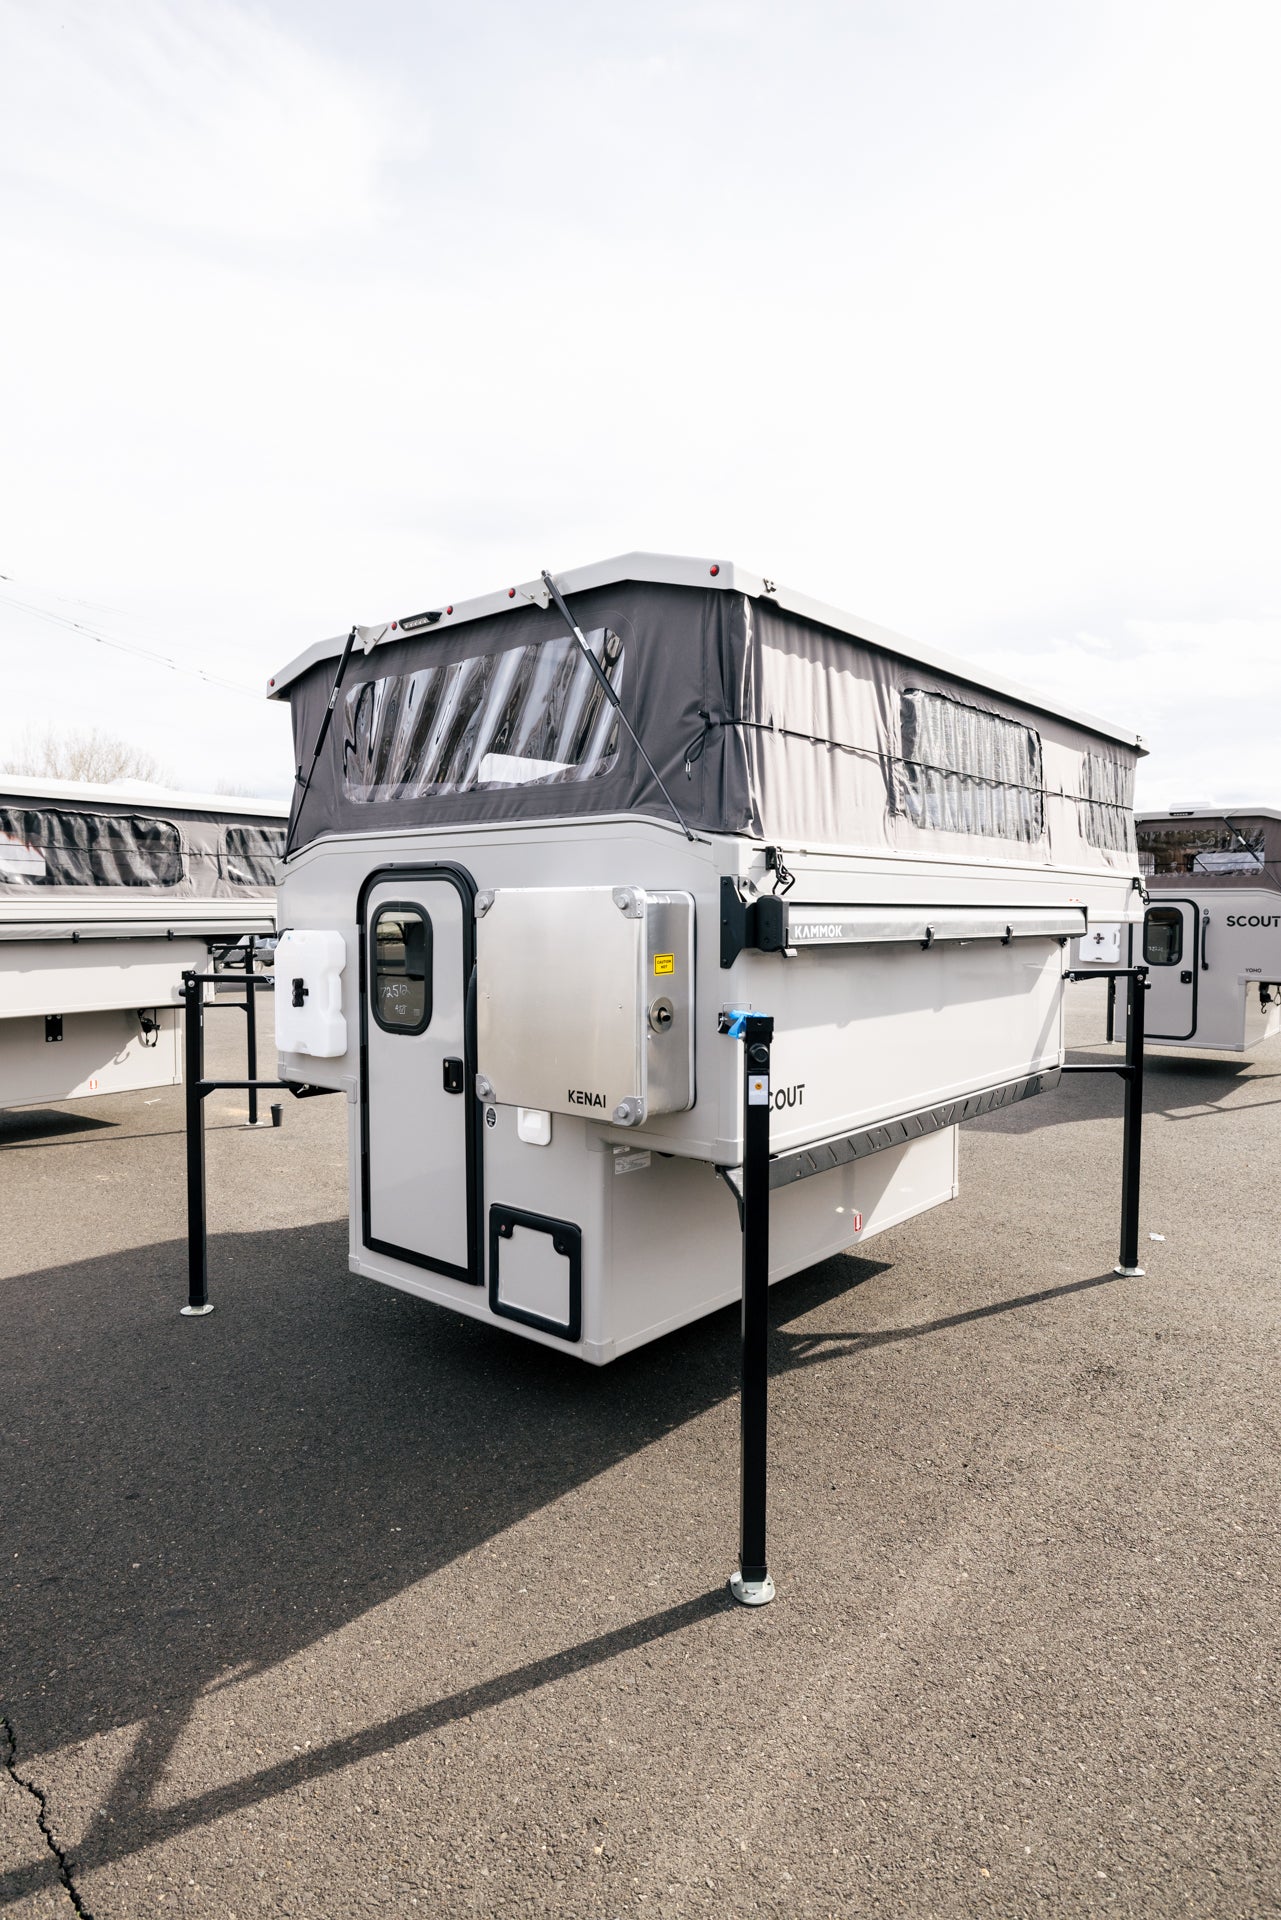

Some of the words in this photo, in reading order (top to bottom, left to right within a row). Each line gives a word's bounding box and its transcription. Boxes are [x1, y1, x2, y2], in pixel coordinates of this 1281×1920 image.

[1226, 915, 1281, 927] SCOUT
[794, 924, 843, 938] KAMMOK
[568, 1089, 606, 1108] KENAI
[769, 1083, 805, 1112] OUT
